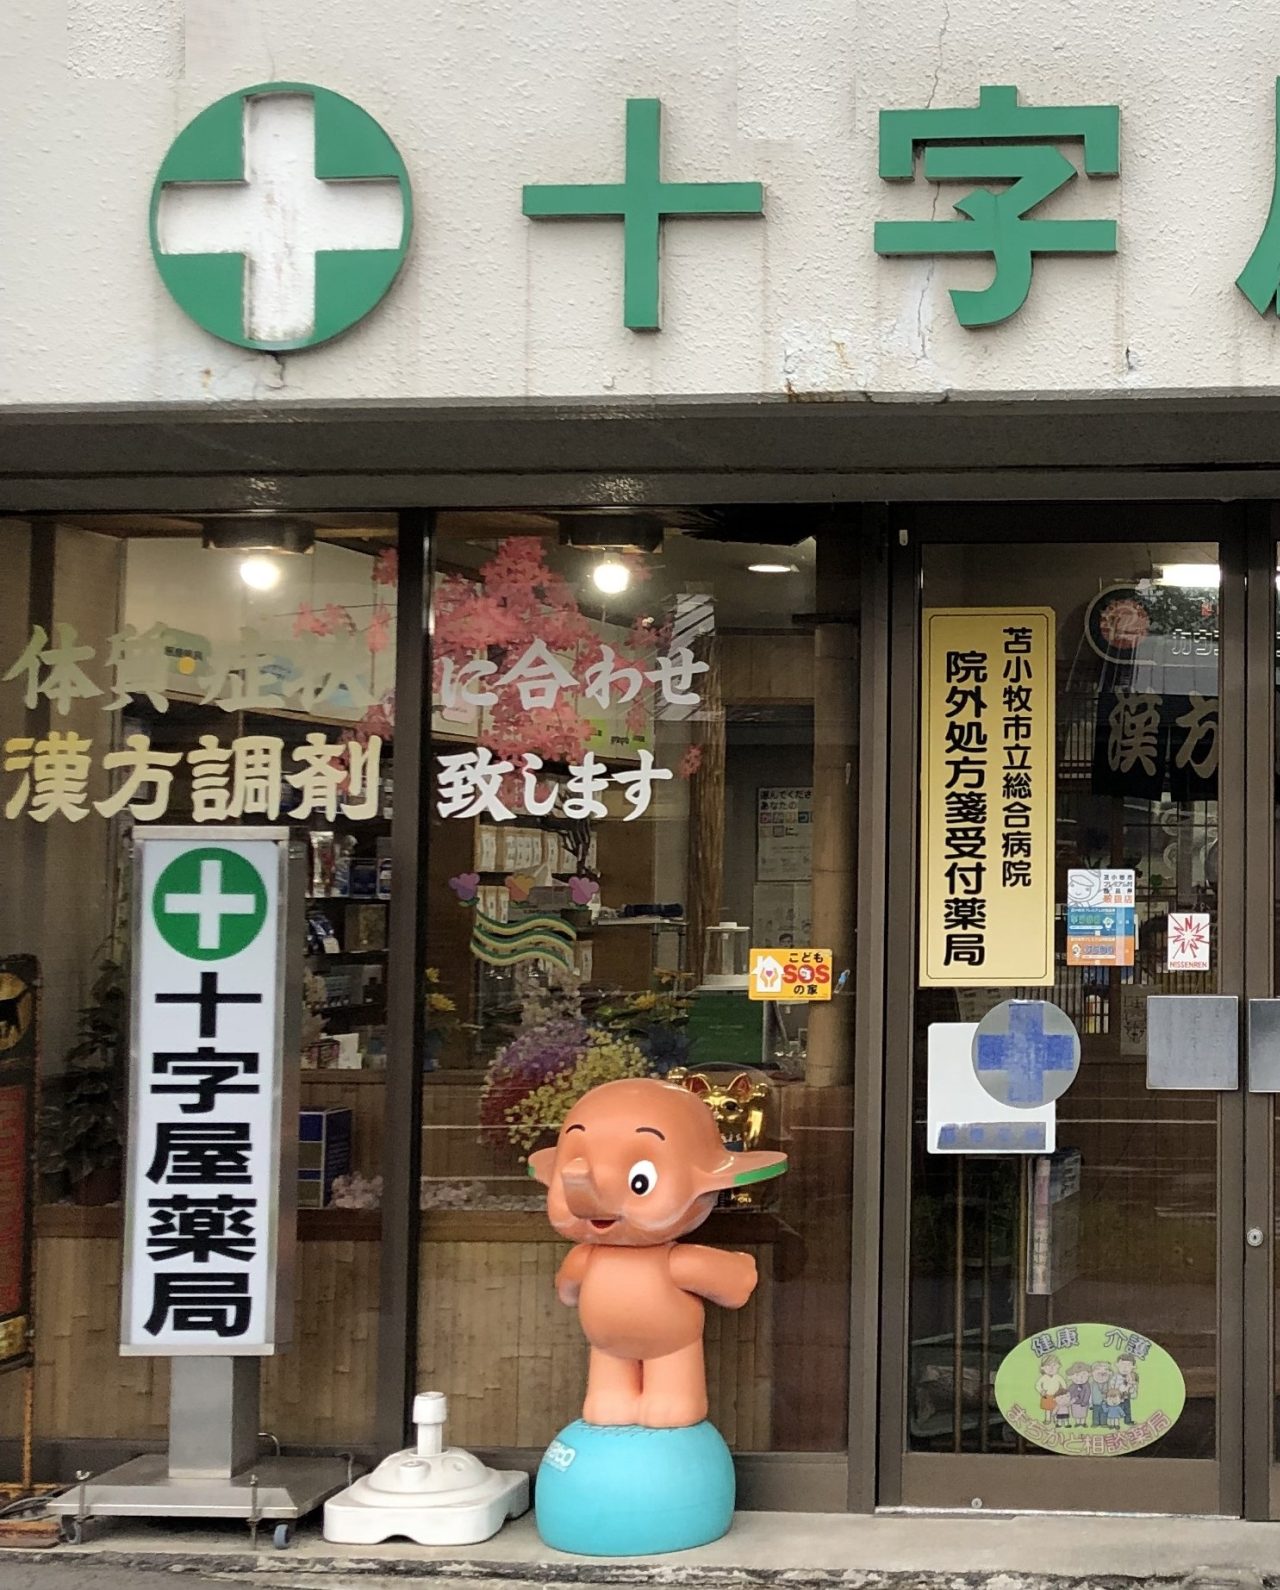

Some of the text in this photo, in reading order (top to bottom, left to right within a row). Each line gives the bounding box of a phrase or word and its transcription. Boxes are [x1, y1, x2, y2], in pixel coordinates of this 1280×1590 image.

[1001, 626, 1033, 888] 苫小牧市立総合病院
[943, 649, 988, 968] 院外処方箋受付薬局
[782, 964, 831, 984] SOS
[788, 952, 824, 963] こども
[1169, 961, 1208, 969] NISSENREN
[793, 985, 818, 995] の家
[143, 971, 263, 1338] 十字屋薬局
[1031, 1327, 1152, 1361] 健康 介護
[1007, 1403, 1172, 1455] まちかど相談薬局
